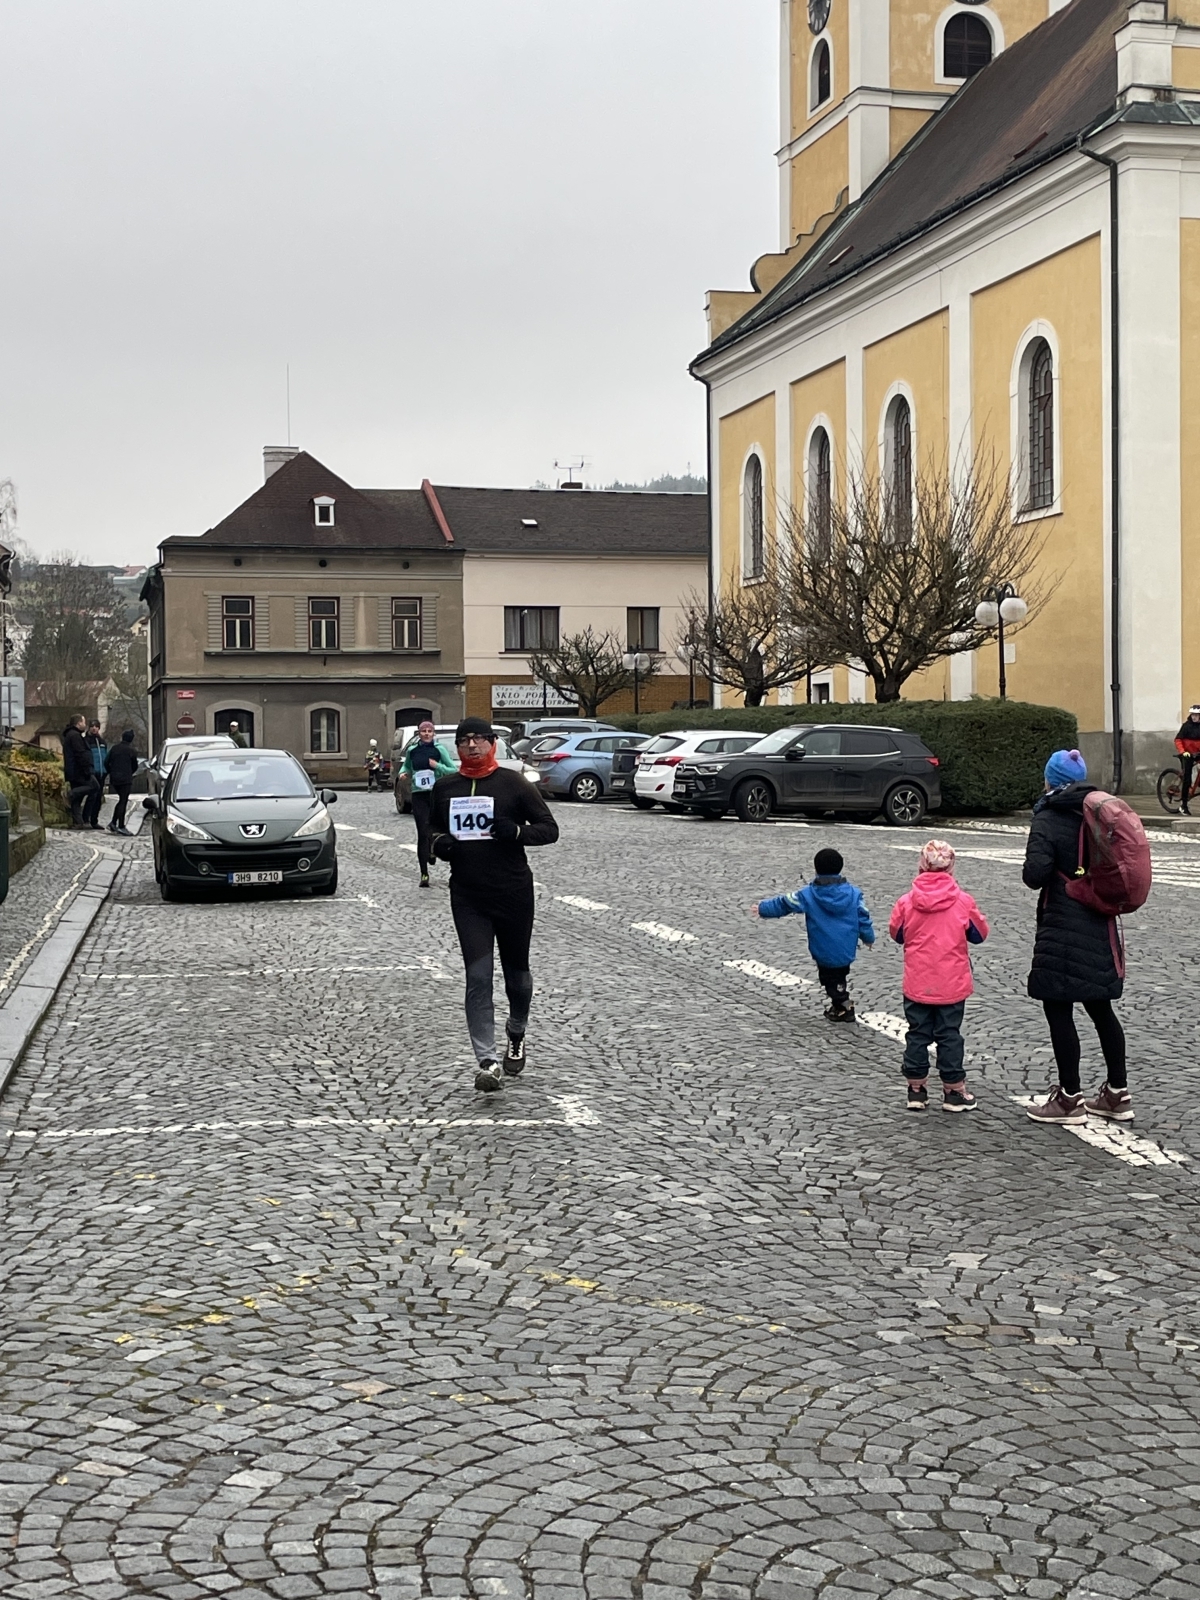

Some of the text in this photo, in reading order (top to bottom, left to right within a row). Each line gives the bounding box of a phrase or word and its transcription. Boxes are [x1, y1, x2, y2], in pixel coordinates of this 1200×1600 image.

[421, 777, 430, 786] 81
[453, 813, 488, 831] 140
[235, 872, 279, 883] 3H9 8210
